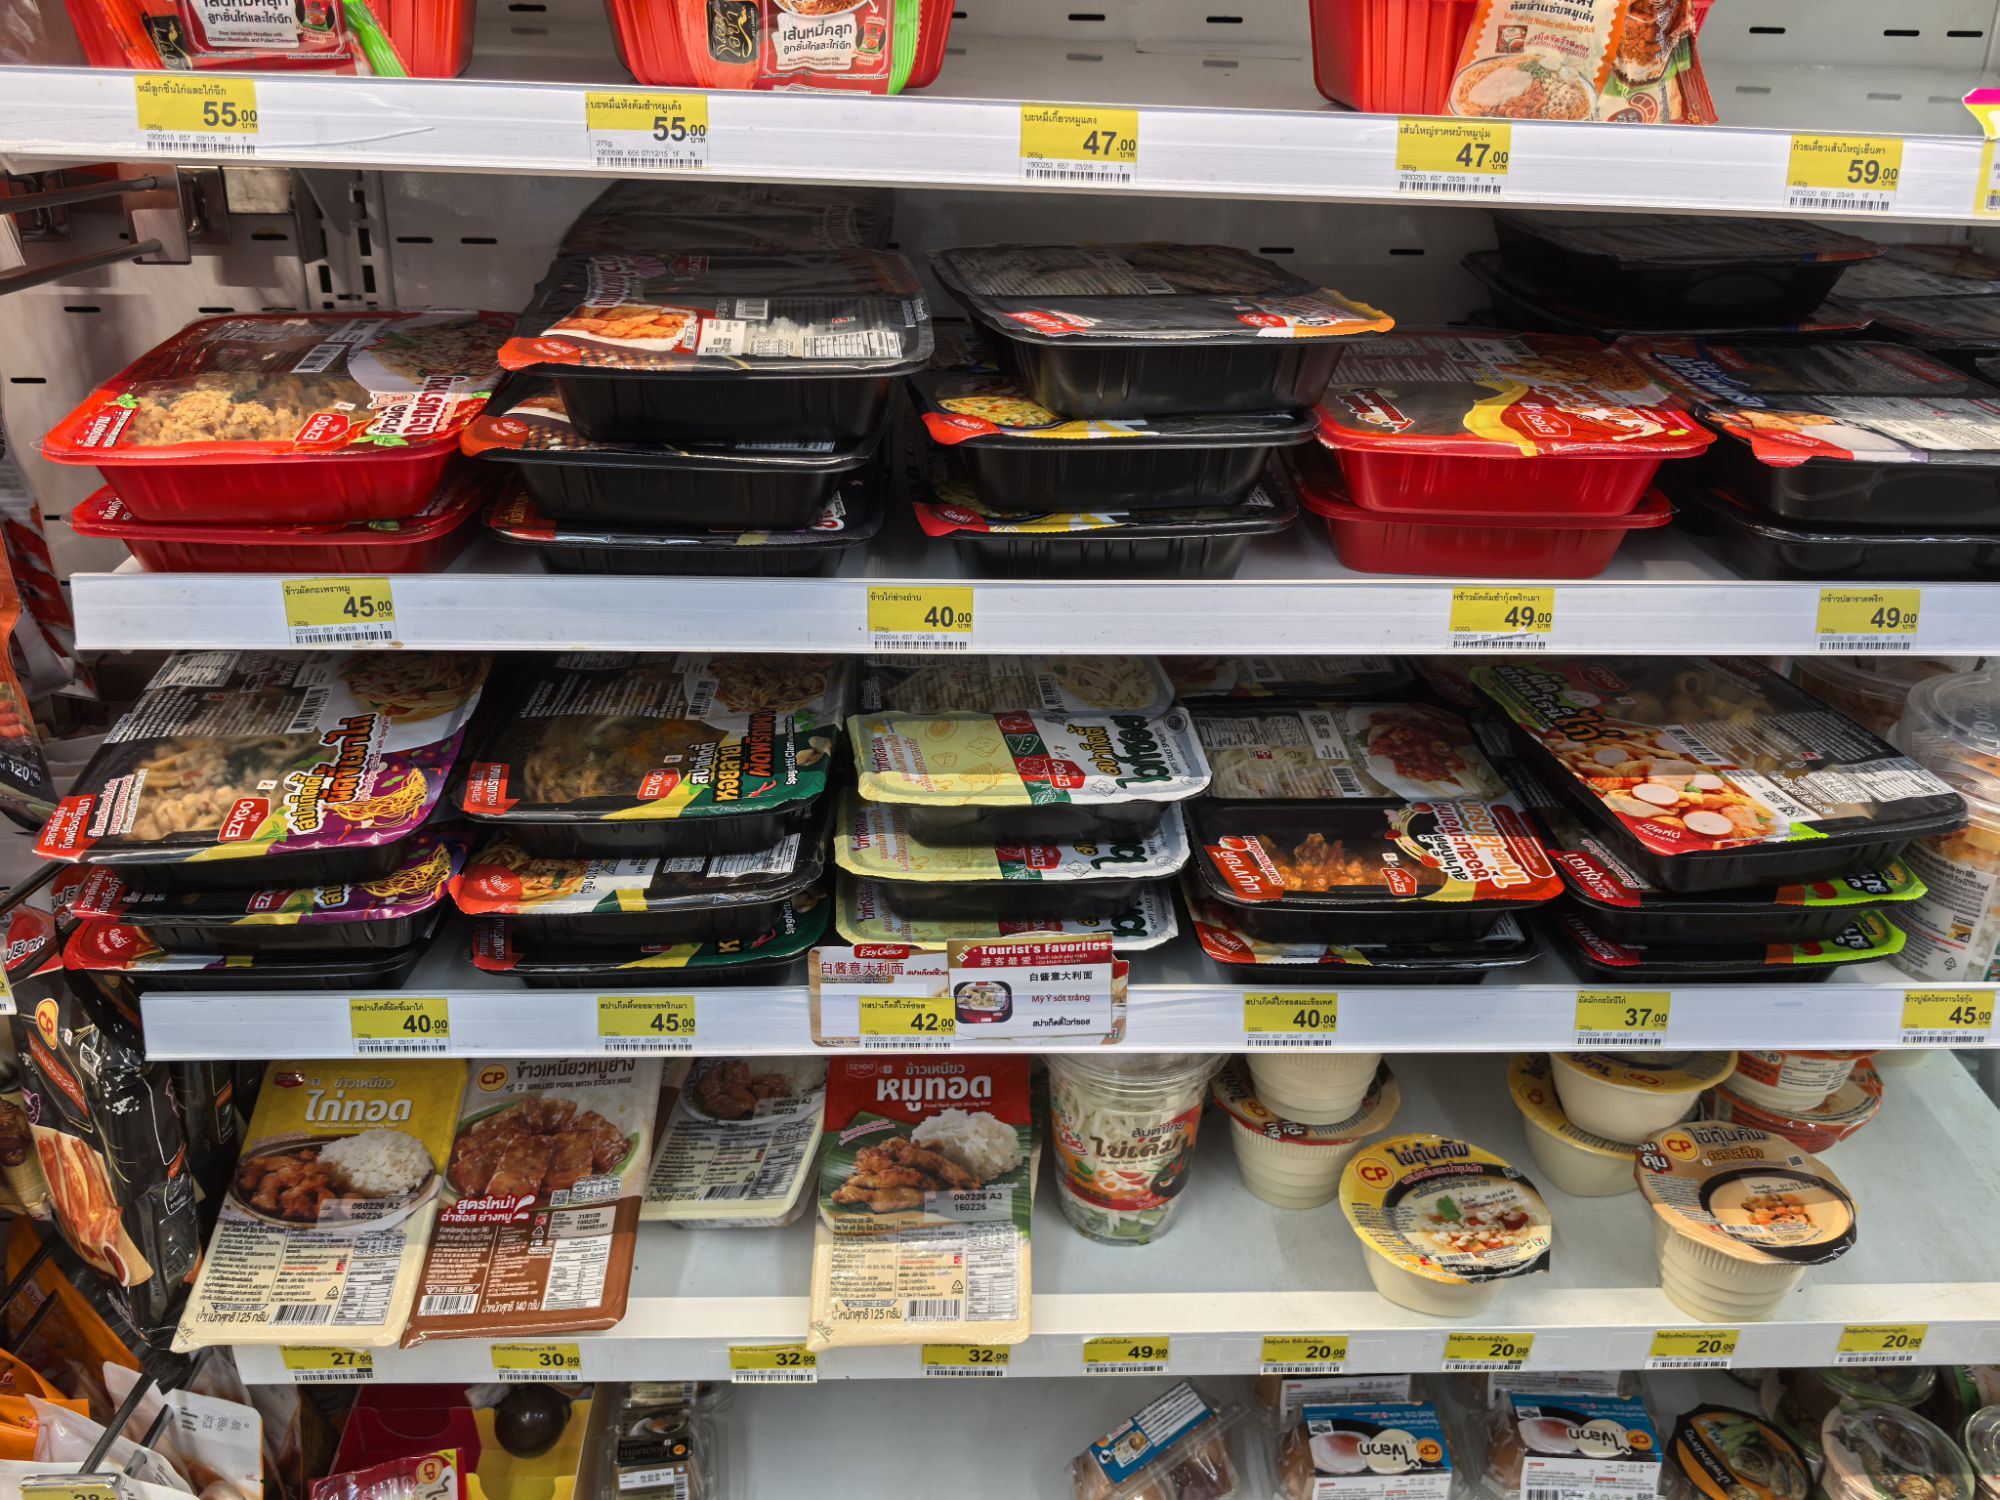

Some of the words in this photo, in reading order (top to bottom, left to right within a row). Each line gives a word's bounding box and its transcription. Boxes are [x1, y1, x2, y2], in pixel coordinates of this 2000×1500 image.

[783, 20, 852, 42] เส้นหมี่คลุก
[204, 101, 257, 127] 55.00
[653, 116, 706, 142] 55.00
[1082, 130, 1136, 156] 47.00
[1456, 143, 1508, 168] 47.00
[1847, 159, 1898, 184] 59.00
[305, 414, 333, 442] EZYGO
[343, 595, 392, 618] 45.00
[924, 606, 972, 628] 40.00
[1504, 606, 1552, 628] 49.00
[1870, 607, 1917, 629] 49.00
[312, 713, 378, 804] ผัดขี้เมาไก่
[1109, 715, 1172, 790] ไวท์ซอส
[715, 744, 742, 801] หอยลาย
[1051, 760, 1071, 787] EZYGO
[644, 771, 665, 798] EZYGO
[224, 800, 255, 841] EZYGO
[1642, 820, 1682, 842] เปิดที่
[1435, 801, 1490, 882] ซอสมะเขือเทศ
[1458, 801, 1528, 887] ไก่และไส้กรอก
[980, 945, 1041, 955] Tourist's
[1044, 941, 1108, 953] Favorites
[821, 961, 904, 976] 白酱意大利面
[403, 1014, 448, 1033] 40.00
[650, 1013, 695, 1032] 45.00
[910, 1013, 954, 1032] 42.00
[1293, 1009, 1337, 1028] 40.00
[1624, 1008, 1667, 1027] 37.00
[1949, 1006, 1992, 1025] 45.00
[481, 1072, 505, 1085] CP
[516, 1058, 636, 1080] ข้าวเหนียวหมูย่าง
[905, 1063, 966, 1076] ข้าวเหนียว
[334, 1076, 395, 1089] ข้าวเหนียว
[555, 1081, 575, 1089] PORK
[575, 1080, 593, 1088] WITH
[616, 1077, 632, 1085] RICE
[877, 1074, 992, 1112] หมูทอด
[305, 1088, 413, 1122] ไก่ทอด
[1131, 1119, 1187, 1140] ส้มตำไทย
[1689, 1126, 1770, 1147] ไข่ตุ๋นคัพ
[1386, 1139, 1471, 1169] ไข่ตุ๋นคัพ
[1665, 1137, 1692, 1153] CP
[1361, 1166, 1388, 1182] CP
[352, 1202, 386, 1210] 060226
[387, 1202, 400, 1210] A2
[456, 1194, 515, 1213] สูตรใหม่!
[954, 1193, 987, 1201] 060226
[989, 1192, 1003, 1200] A3
[351, 1212, 383, 1220] 160226
[440, 1208, 477, 1222] ฉ่ำซอส
[479, 1209, 512, 1223] ย่างหมู
[954, 1203, 987, 1211] 160226
[236, 1312, 251, 1323] 125
[252, 1309, 269, 1323] กรัม
[831, 1306, 870, 1324] น้ำหนักสุทธิ
[870, 1308, 884, 1320] 125
[886, 1306, 901, 1320] กรัม
[1488, 1343, 1529, 1357] 20.00
[1695, 1340, 1736, 1353] 20.00
[1881, 1334, 1922, 1348] 20.00
[330, 1352, 372, 1366] 27.00
[539, 1353, 580, 1367] 30.00
[775, 1352, 816, 1366] 32.00
[968, 1349, 1008, 1362] 32.00
[1127, 1345, 1168, 1359] 49.00
[1305, 1345, 1346, 1359] 20.00
